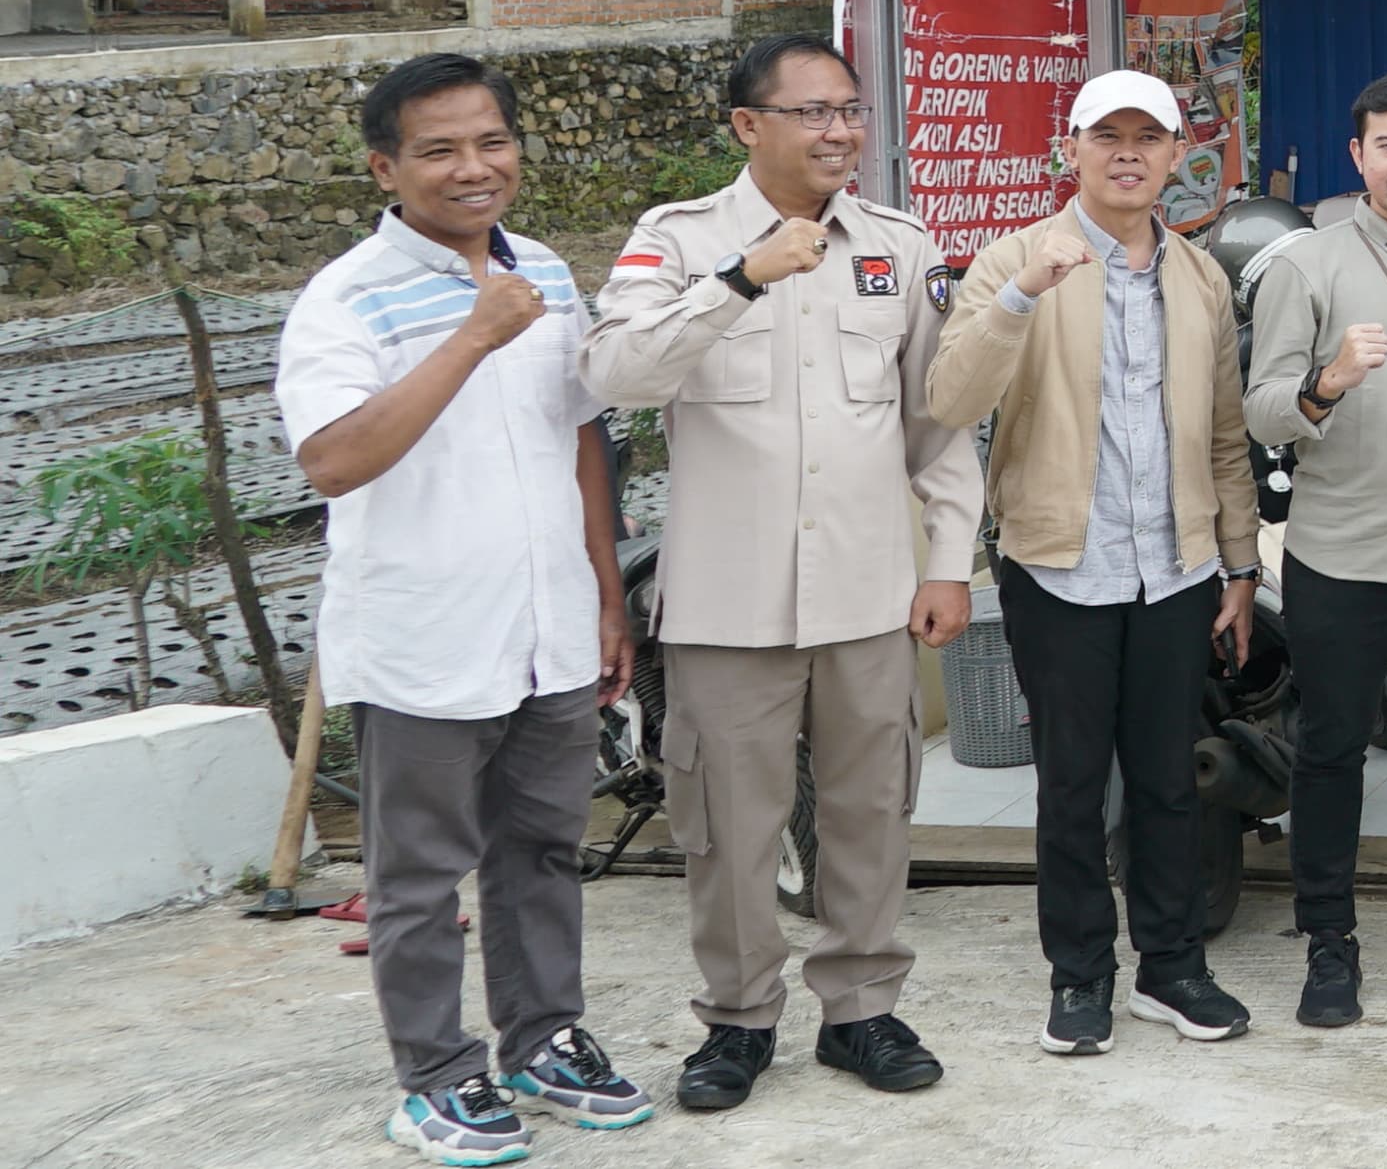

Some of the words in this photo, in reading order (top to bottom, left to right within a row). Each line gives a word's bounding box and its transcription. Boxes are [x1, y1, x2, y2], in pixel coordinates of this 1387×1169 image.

[929, 51, 1012, 82] GORENG
[1016, 55, 1029, 82] &
[954, 124, 1003, 152] ASLI
[976, 157, 1041, 187] INSTAN
